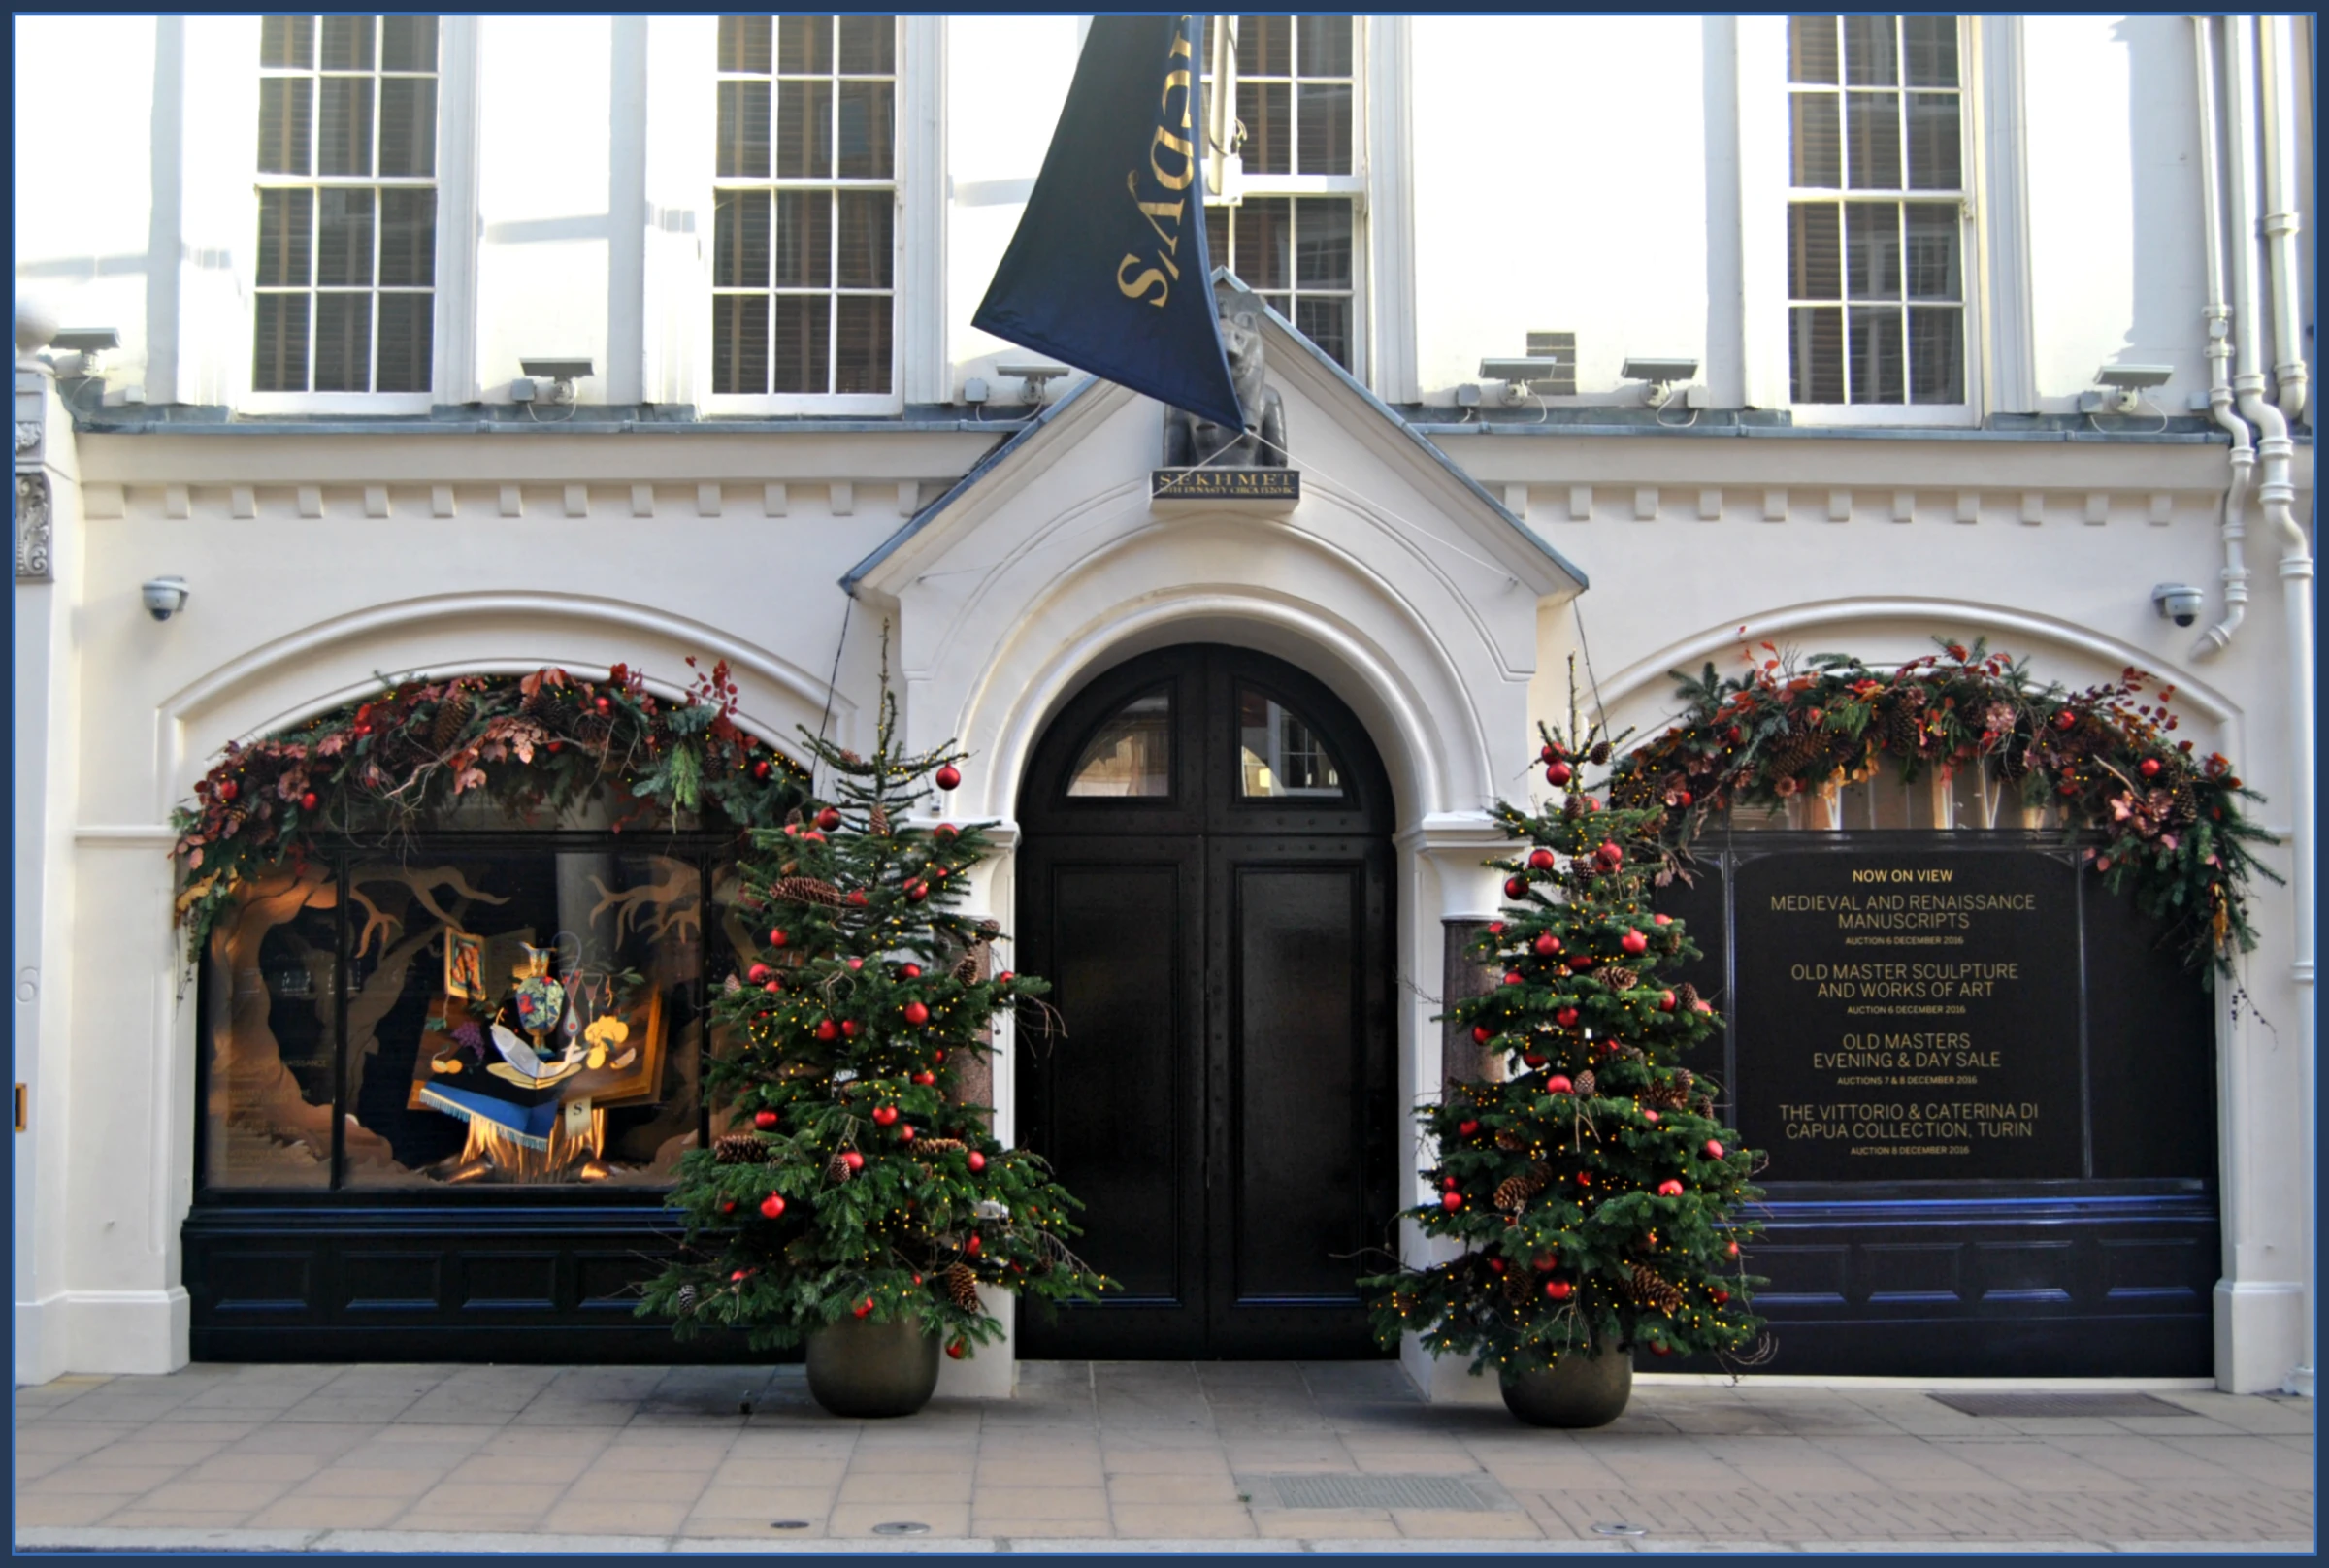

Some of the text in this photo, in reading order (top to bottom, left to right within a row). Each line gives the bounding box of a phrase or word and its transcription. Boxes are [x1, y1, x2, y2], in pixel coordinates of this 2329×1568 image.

[1160, 473, 1295, 485] SEKHMET
[1853, 868, 1953, 883] NOW ON VIEW
[1770, 894, 2036, 911] MEDIEVAL AND RENAISSANCE
[1838, 912, 1971, 930] MANUSCRIPTS
[1845, 936, 1964, 946] AUCTION 6 DECEMBER 2016
[1791, 963, 2019, 980] OLD MASTER SCULPTURE
[1818, 981, 1995, 998] AND WORKS OF ART
[1847, 1005, 1966, 1015] AUCTION 6 DECEMBER 2016
[1843, 1033, 1971, 1051] OLD MASTERS
[1814, 1051, 2001, 1068] EVENING & DAY SALE
[1837, 1075, 1978, 1085] AUCTIONS 7 & 8 DECEMBER 2016
[1779, 1103, 2039, 1121] THE VITTORIO & CATERINA DI
[1786, 1122, 1849, 1140] CAPUA
[1978, 1122, 2033, 1140] TURIN
[1851, 1146, 1970, 1156] AUCTION 8 DECEMBER 2016
